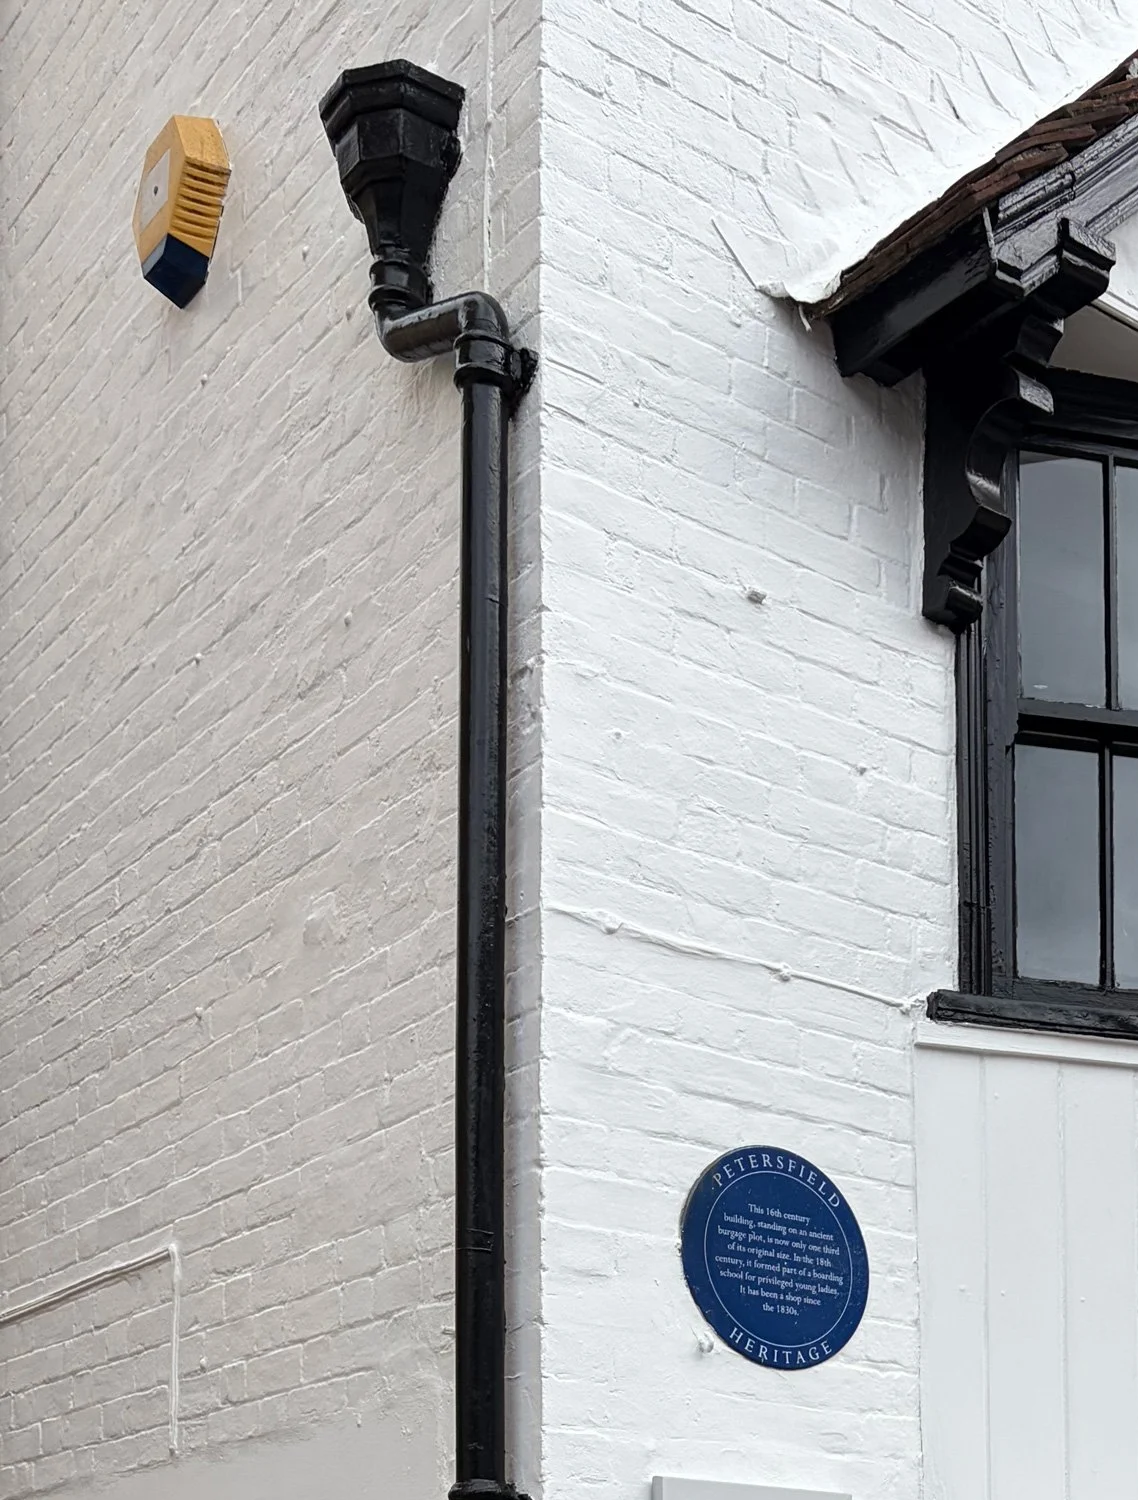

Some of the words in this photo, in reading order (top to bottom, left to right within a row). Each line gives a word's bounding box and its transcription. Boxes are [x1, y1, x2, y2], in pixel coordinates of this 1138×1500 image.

[713, 1153, 840, 1208] PETERSFIELD
[724, 1212, 756, 1229] building,
[758, 1222, 786, 1235] standing
[809, 1230, 834, 1241] ancient
[748, 1203, 764, 1214] This
[766, 1207, 782, 1218] 16th
[783, 1212, 810, 1226] century
[718, 1225, 746, 1241] burgage
[748, 1231, 766, 1243] plot,
[774, 1238, 790, 1246] now
[792, 1240, 807, 1252] only
[822, 1246, 840, 1256] third
[728, 1242, 736, 1250] of
[747, 1247, 774, 1259] original
[776, 1252, 791, 1260] size.
[794, 1253, 802, 1261] In
[802, 1255, 813, 1264] the
[816, 1258, 831, 1267] 18th
[715, 1255, 745, 1268] century,
[754, 1260, 780, 1272] formed
[782, 1266, 797, 1275] part
[799, 1268, 806, 1276] of
[813, 1269, 843, 1285] boarding
[720, 1268, 743, 1279] school
[745, 1272, 755, 1281] for
[758, 1276, 793, 1290] privileged
[795, 1282, 816, 1294] young
[740, 1285, 745, 1294] It
[748, 1286, 759, 1296] has
[761, 1288, 778, 1299] been
[786, 1294, 801, 1305] shop
[804, 1296, 821, 1305] since
[763, 1303, 774, 1312] the
[776, 1304, 799, 1316] 1830s.
[729, 1327, 832, 1364] HERITAGE
